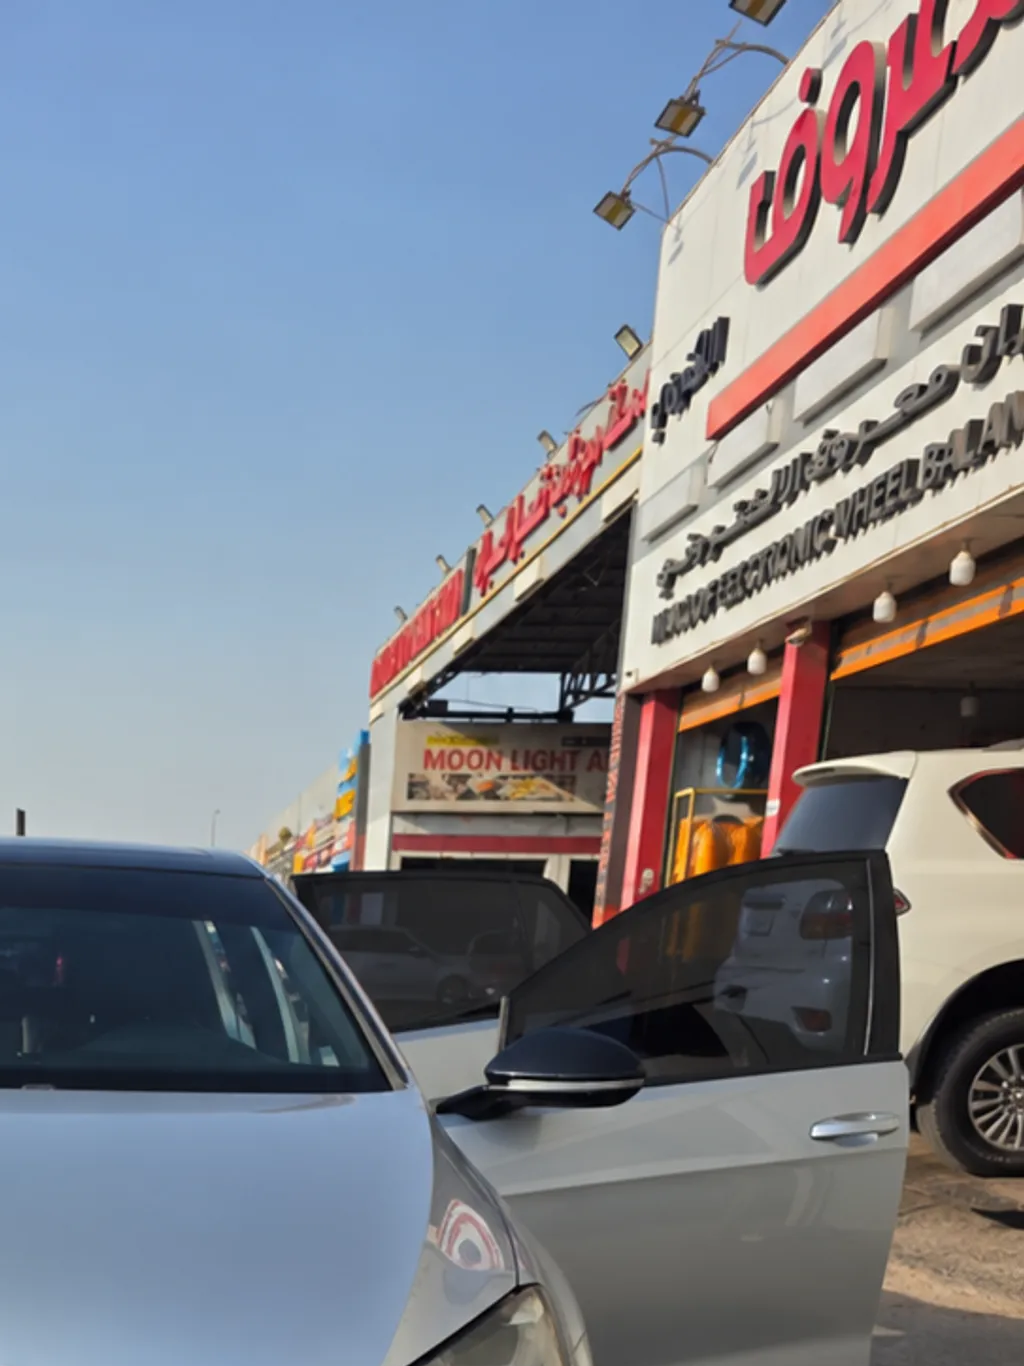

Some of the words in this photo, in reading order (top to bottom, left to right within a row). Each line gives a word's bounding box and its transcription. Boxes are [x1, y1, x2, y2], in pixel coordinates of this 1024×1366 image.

[834, 458, 922, 546] WHEEL
[423, 748, 503, 771] MOON
[510, 749, 578, 773] LIGHT
